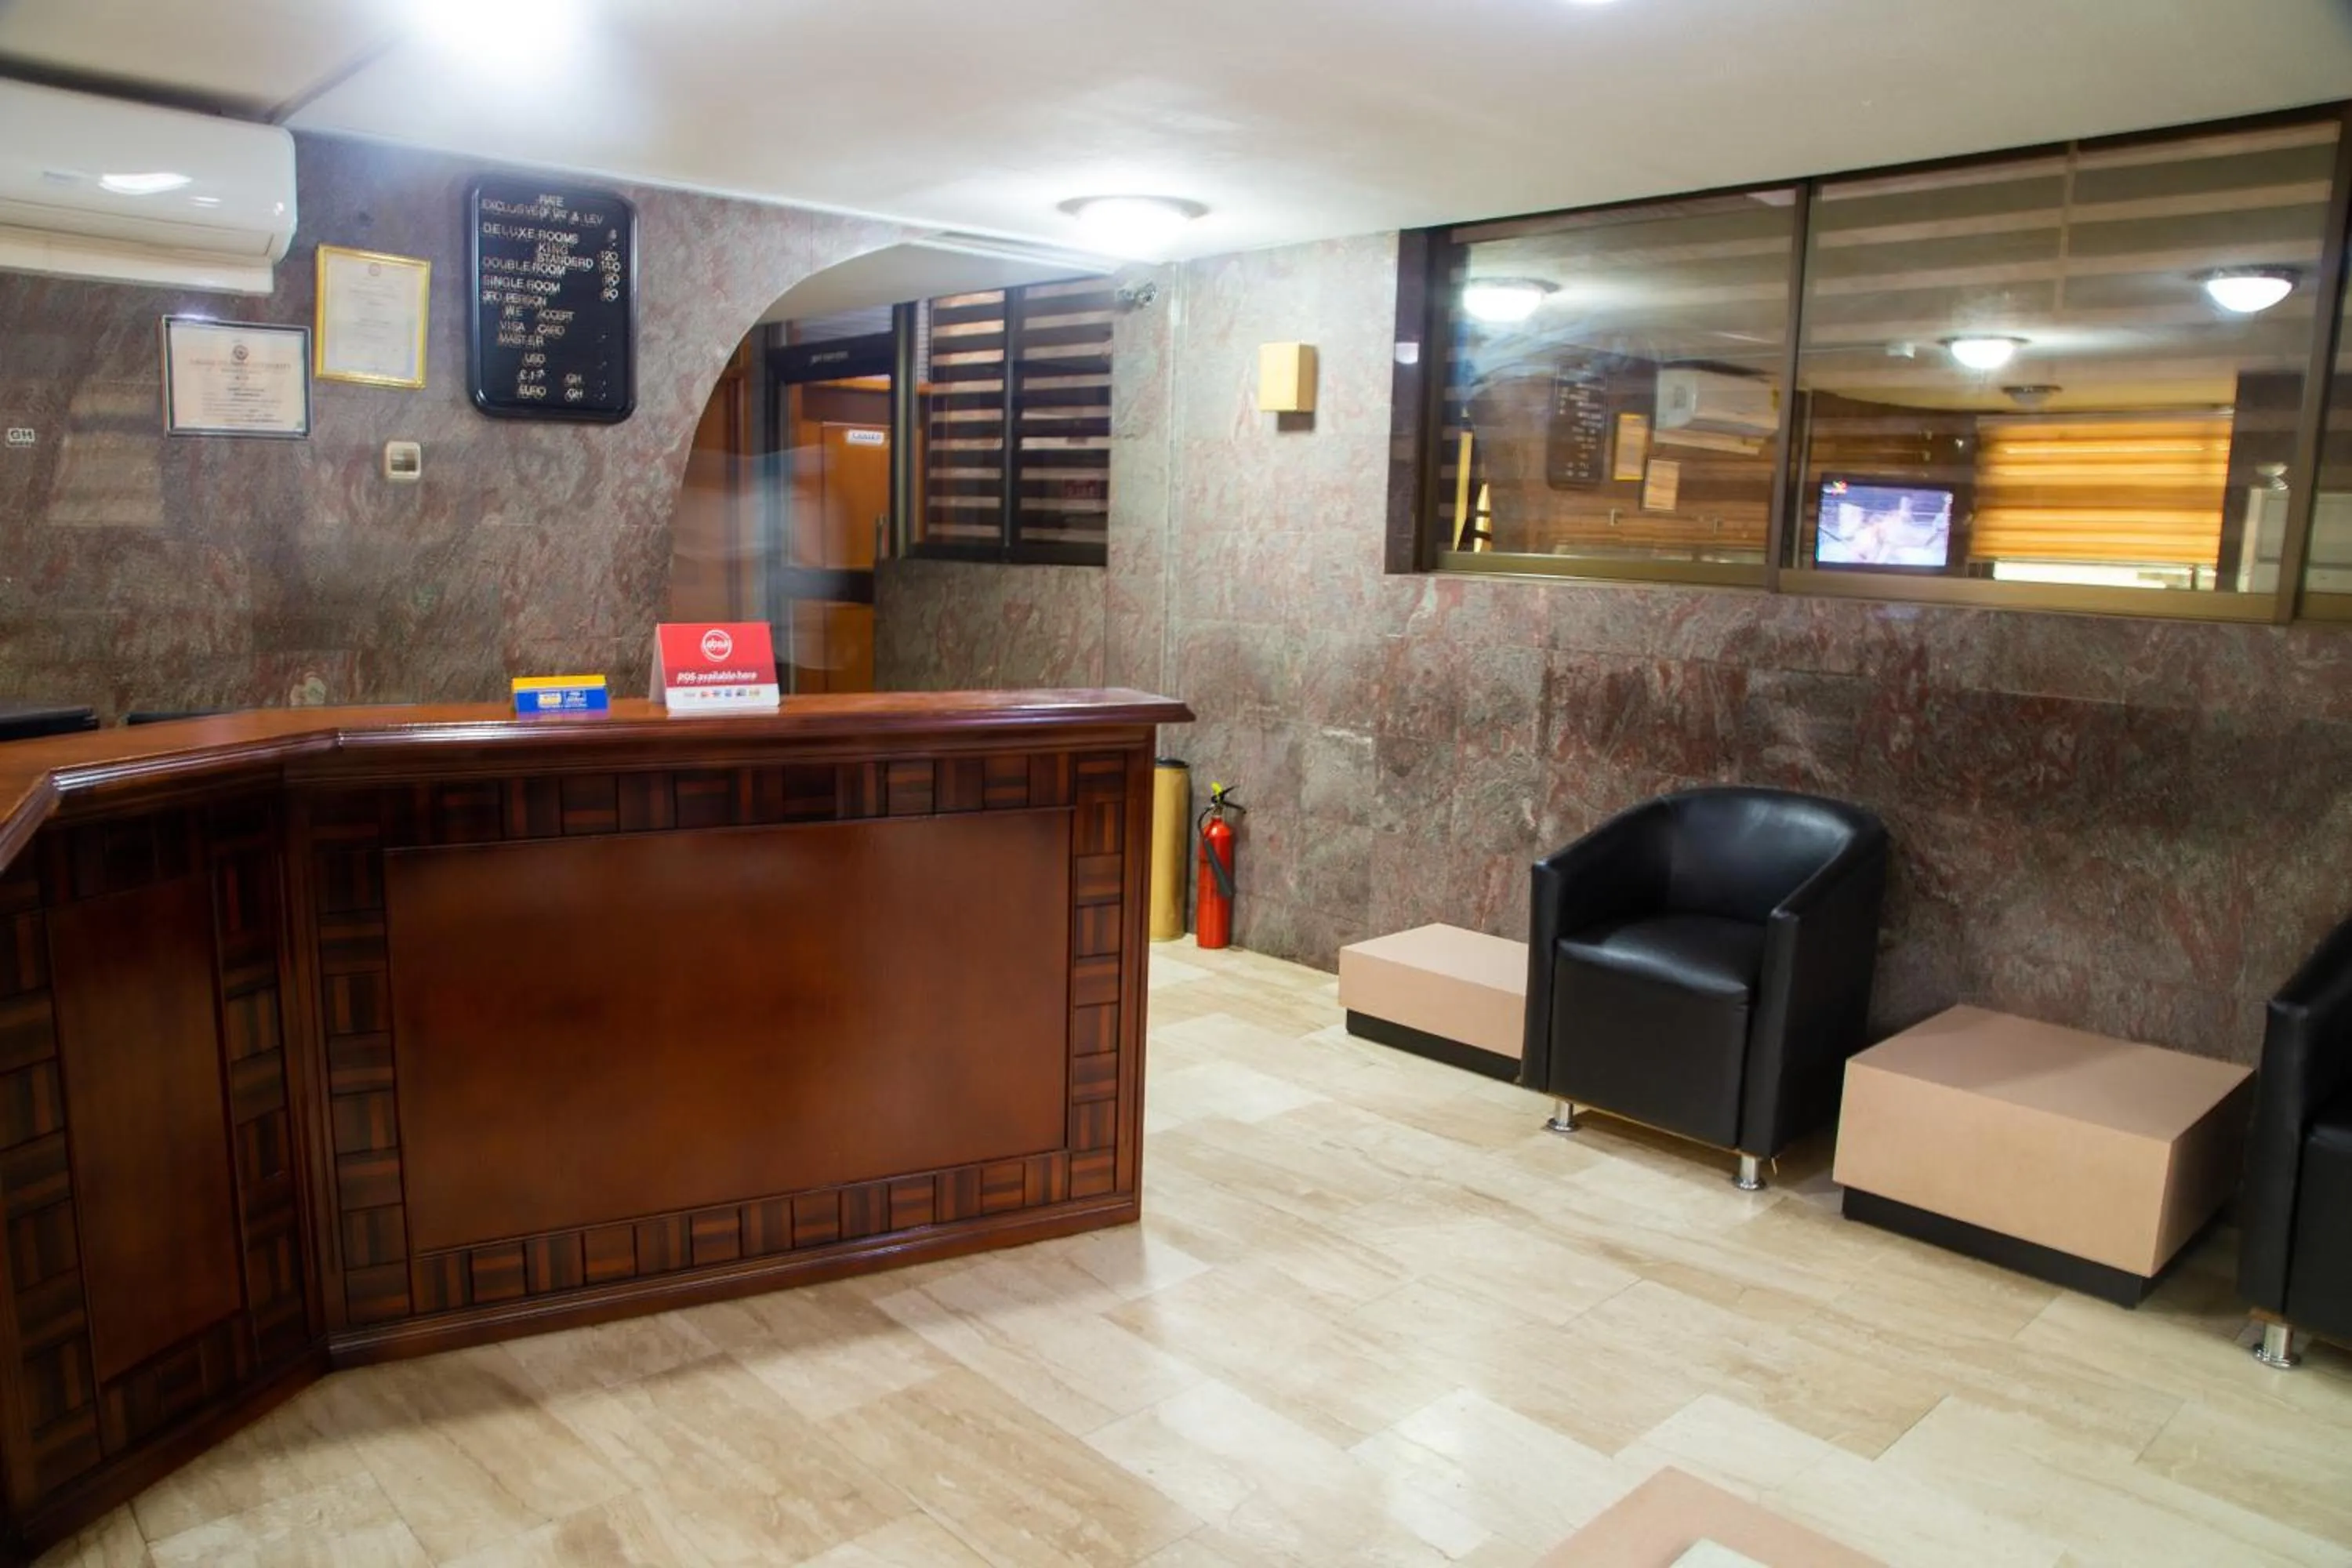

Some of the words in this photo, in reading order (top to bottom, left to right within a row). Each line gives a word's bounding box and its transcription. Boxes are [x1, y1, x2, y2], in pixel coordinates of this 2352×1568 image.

[482, 222, 535, 238] DELUXE
[527, 280, 561, 293] ROOM
[697, 671, 735, 684] available
[737, 670, 757, 681] here
